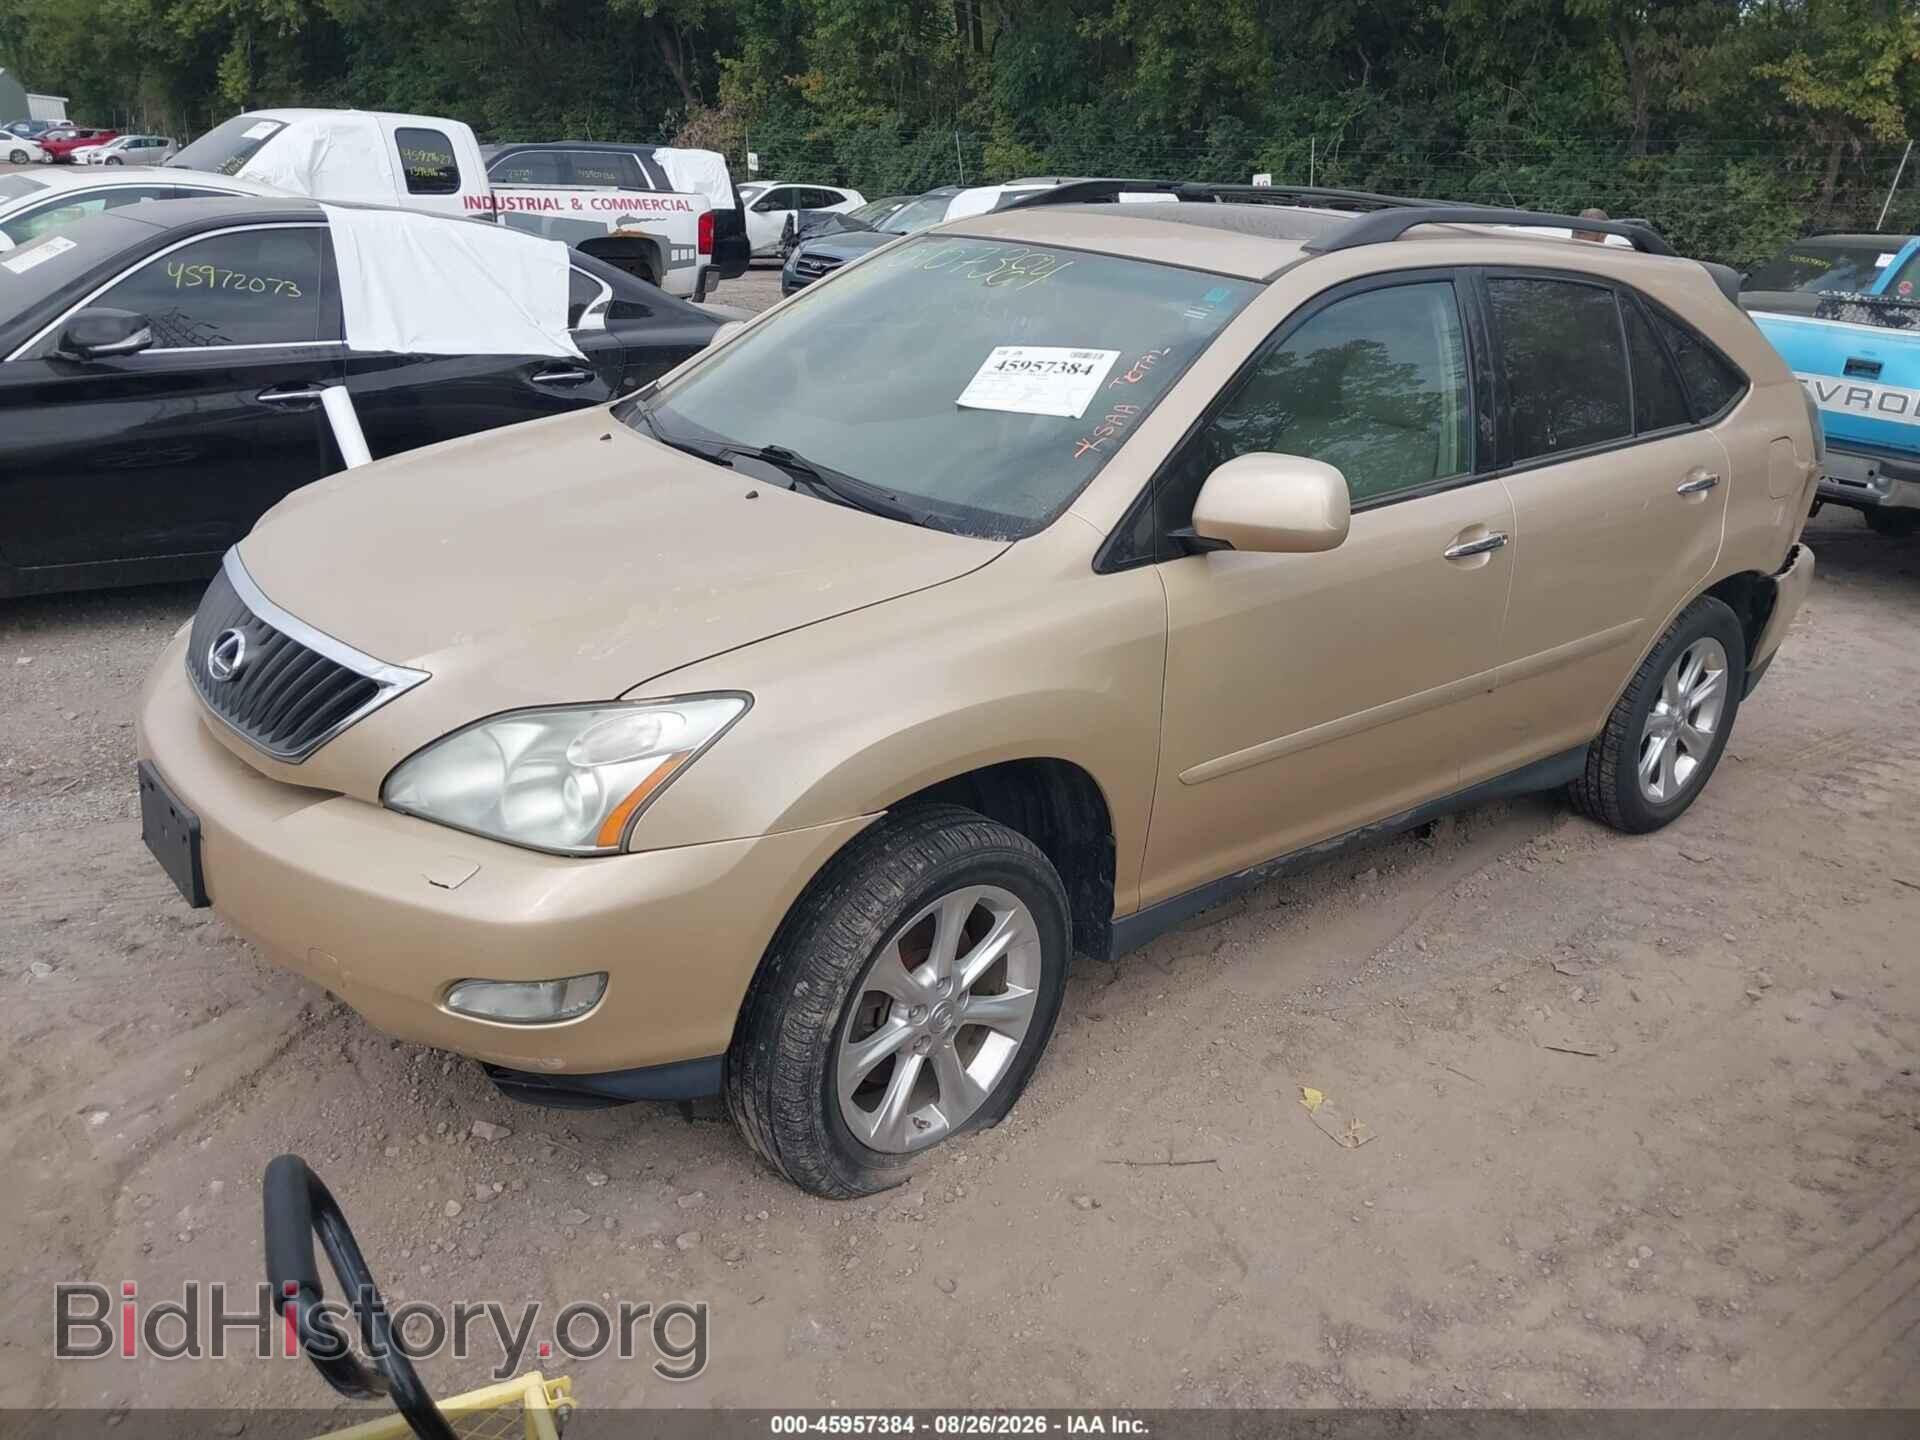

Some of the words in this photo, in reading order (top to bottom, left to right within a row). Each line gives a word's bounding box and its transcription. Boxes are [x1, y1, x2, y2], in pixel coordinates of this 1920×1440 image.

[463, 195, 564, 211] INDUSTRIAL
[571, 198, 583, 210] &
[591, 198, 694, 212] COMMERCIAL
[167, 261, 303, 297] 45972073
[994, 359, 1095, 376] 45957384
